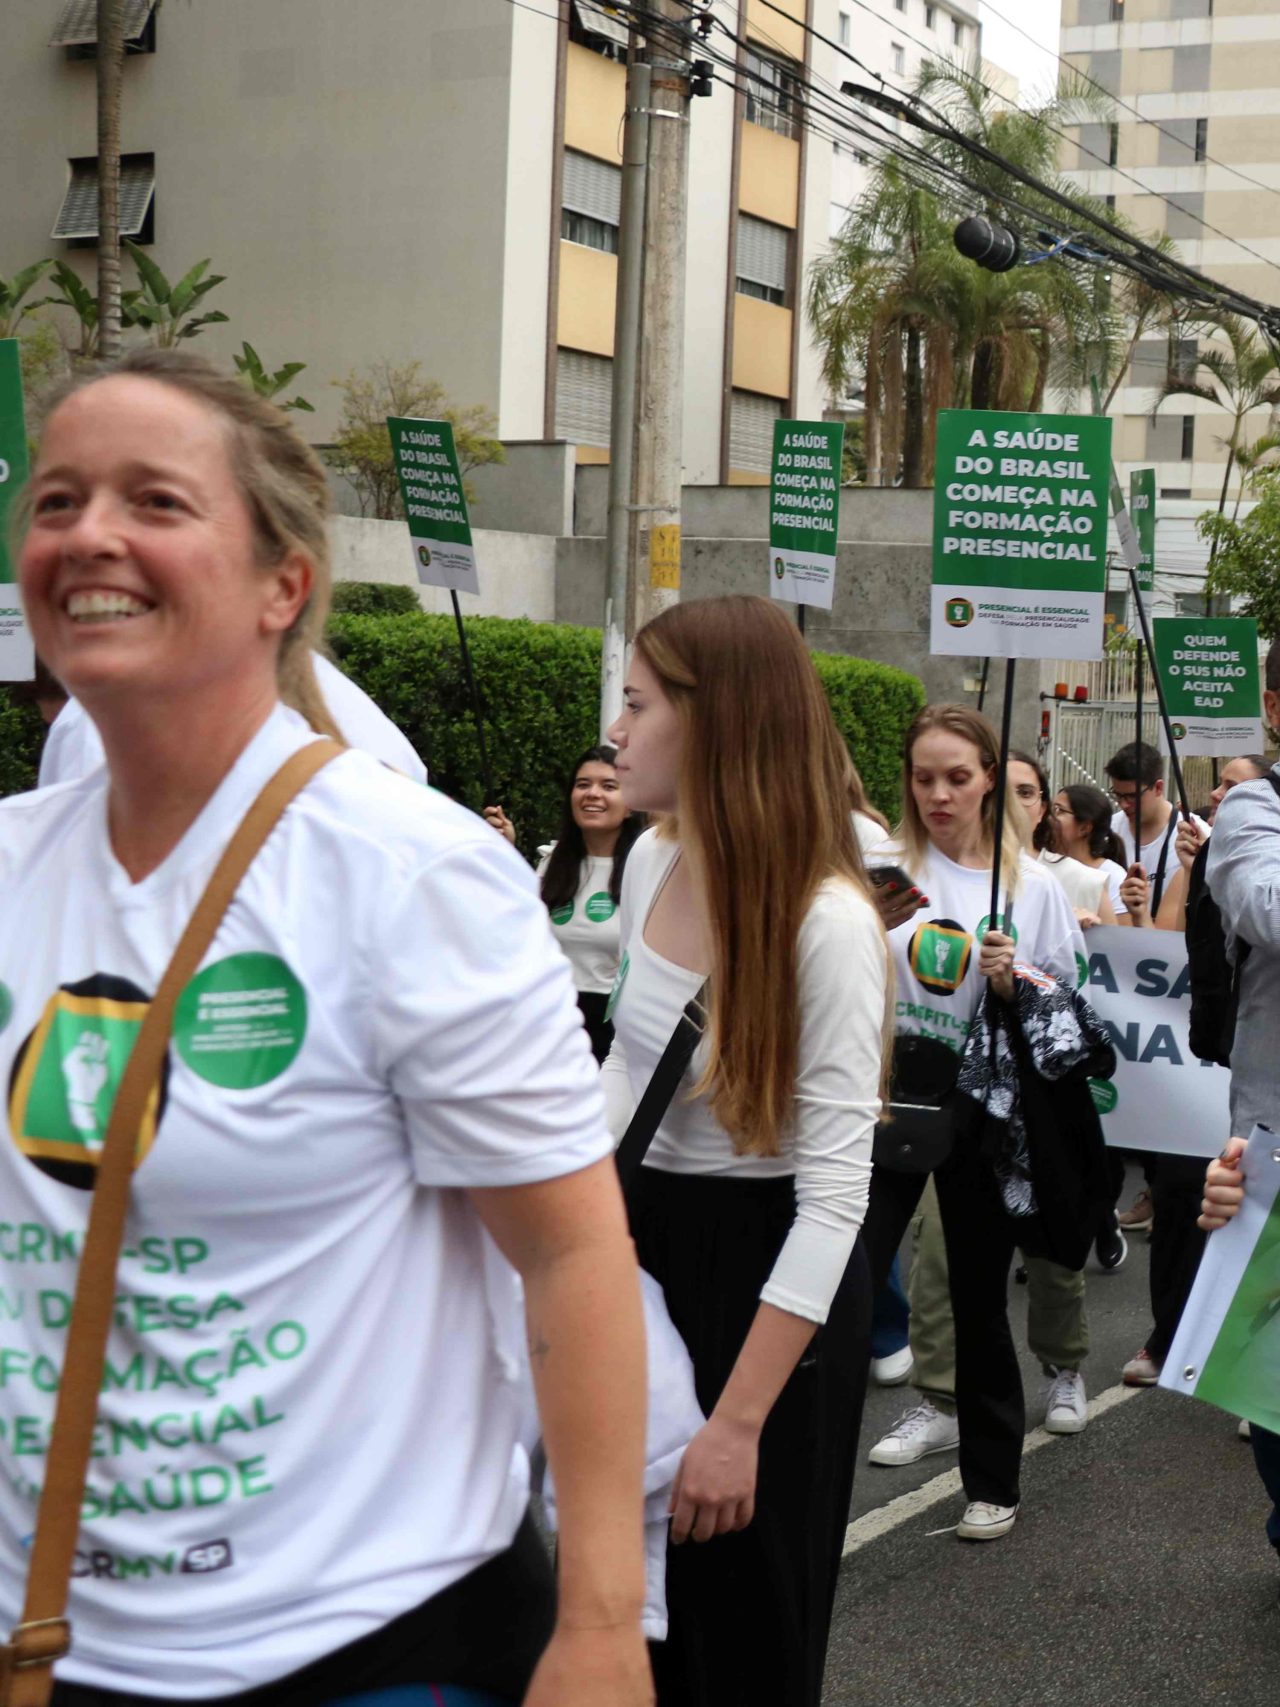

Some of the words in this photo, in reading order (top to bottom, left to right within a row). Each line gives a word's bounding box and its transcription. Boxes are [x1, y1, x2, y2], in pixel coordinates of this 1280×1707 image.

[401, 431, 409, 443] A
[409, 429, 442, 447] SAÚDE
[783, 434, 791, 447] A
[792, 431, 828, 449] SAÚDE
[967, 429, 988, 447] A
[993, 428, 1080, 452] SAÚDE
[400, 449, 415, 462] DO
[415, 450, 451, 467] BRASIL
[778, 453, 792, 467] DO
[794, 454, 833, 470] BRASIL
[955, 456, 994, 475] DO
[1000, 458, 1091, 480] BRASIL
[401, 467, 441, 486] COMEÇA
[442, 473, 458, 486] NA
[774, 472, 818, 492] COMEÇA
[820, 476, 836, 491] NA
[406, 486, 460, 506] FORMAÇÃO
[774, 493, 834, 513] FORMAÇÃO
[946, 482, 1054, 509] COMEÇA
[1060, 488, 1098, 507] NA
[408, 504, 466, 524] PRESENCIAL
[772, 512, 834, 532] PRESENCIAL
[948, 509, 1093, 538] FORMAÇÃO
[943, 536, 1097, 561] PRESENCIAL
[978, 603, 1032, 614] PRESENCIAL
[1042, 607, 1090, 616] ESSENCIAL
[1184, 635, 1227, 648] QUEM
[1173, 650, 1240, 661] DEFENDE
[1168, 665, 1180, 675] O
[1183, 665, 1210, 676] SUS
[1213, 664, 1246, 677] NÃO
[1182, 680, 1234, 692] ACEITA
[1194, 696, 1224, 708] EAD
[1088, 953, 1120, 994] A
[0, 1320, 306, 1397] FOMAÇÃO
